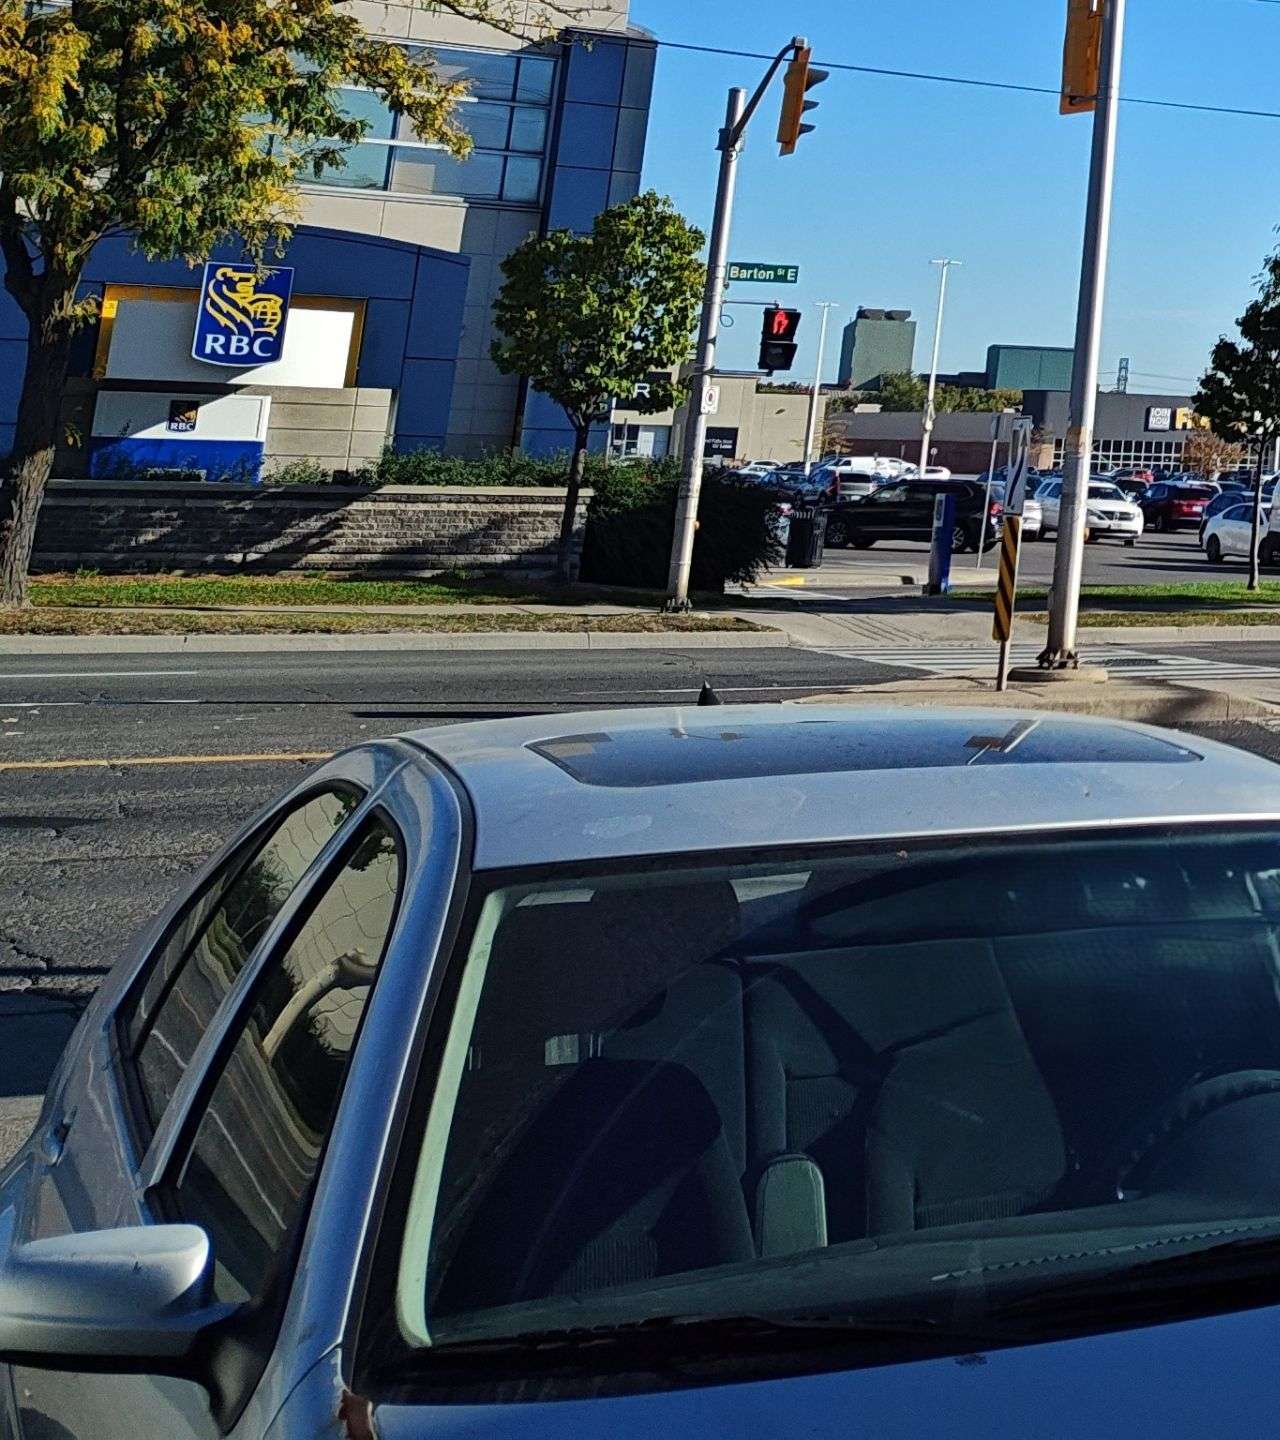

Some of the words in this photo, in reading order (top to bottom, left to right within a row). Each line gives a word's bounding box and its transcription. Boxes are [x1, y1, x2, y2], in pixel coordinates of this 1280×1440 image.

[730, 265, 774, 280] Barton
[787, 268, 797, 280] E
[204, 333, 274, 357] RBC
[170, 421, 194, 432] RBC
